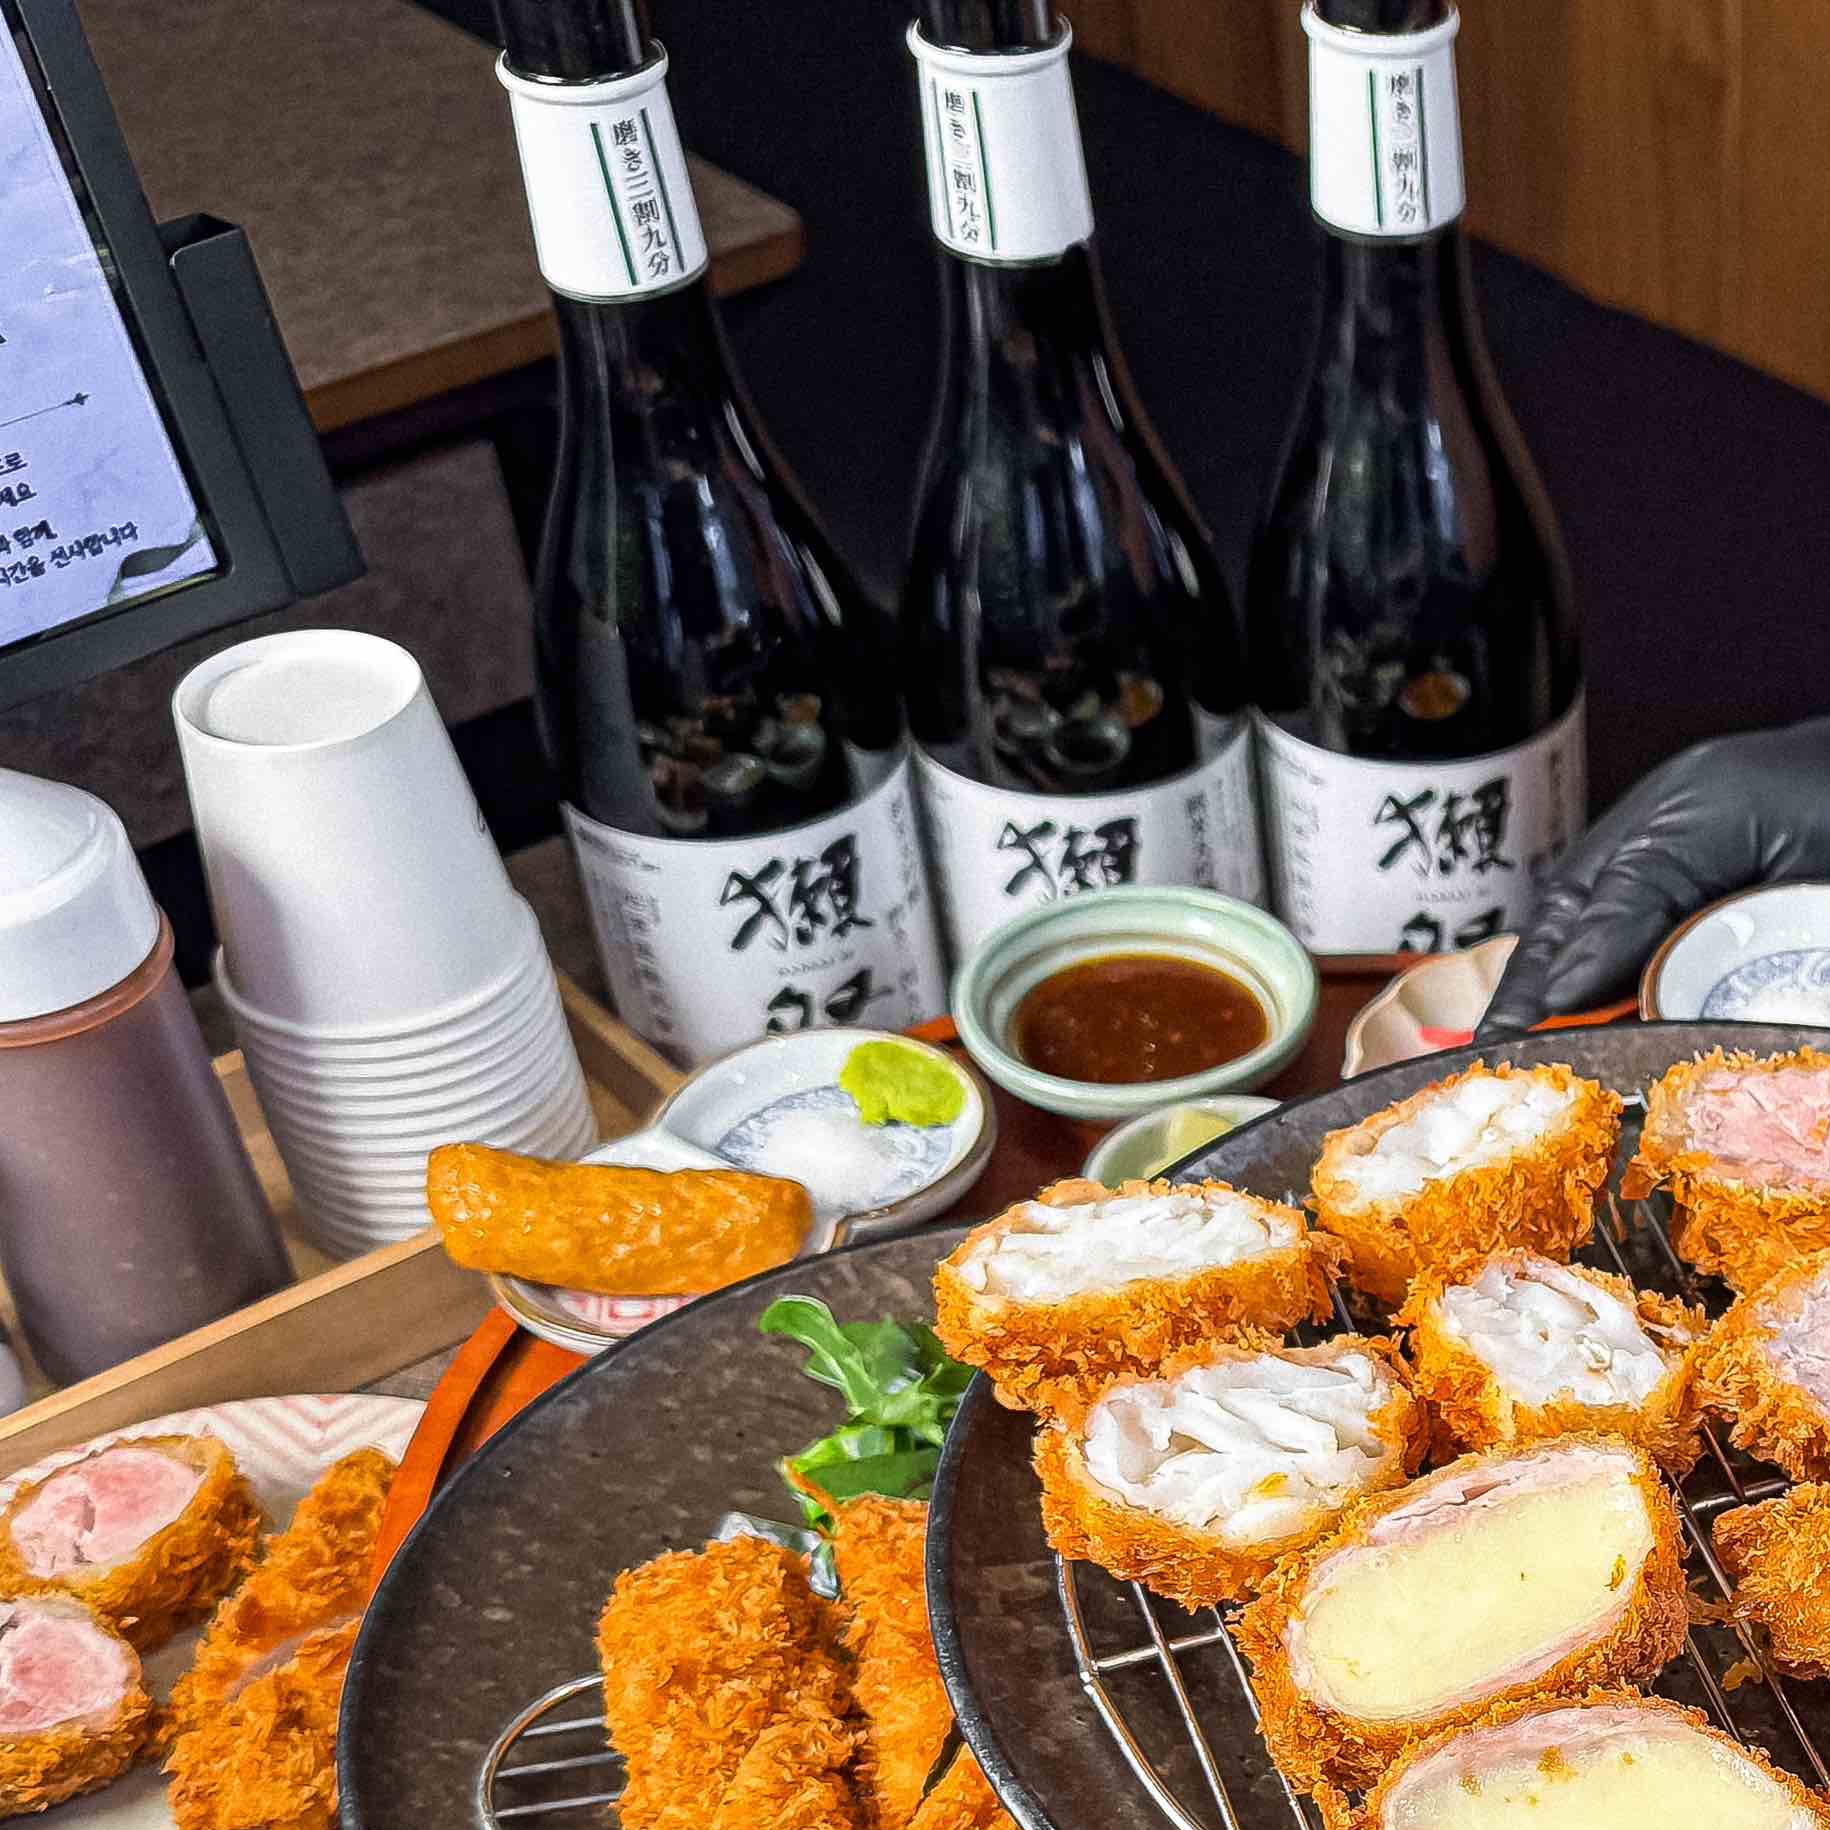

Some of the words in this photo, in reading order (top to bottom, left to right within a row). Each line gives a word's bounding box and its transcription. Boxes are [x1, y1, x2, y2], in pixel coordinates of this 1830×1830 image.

[611, 118, 670, 278] 磨き三割九分
